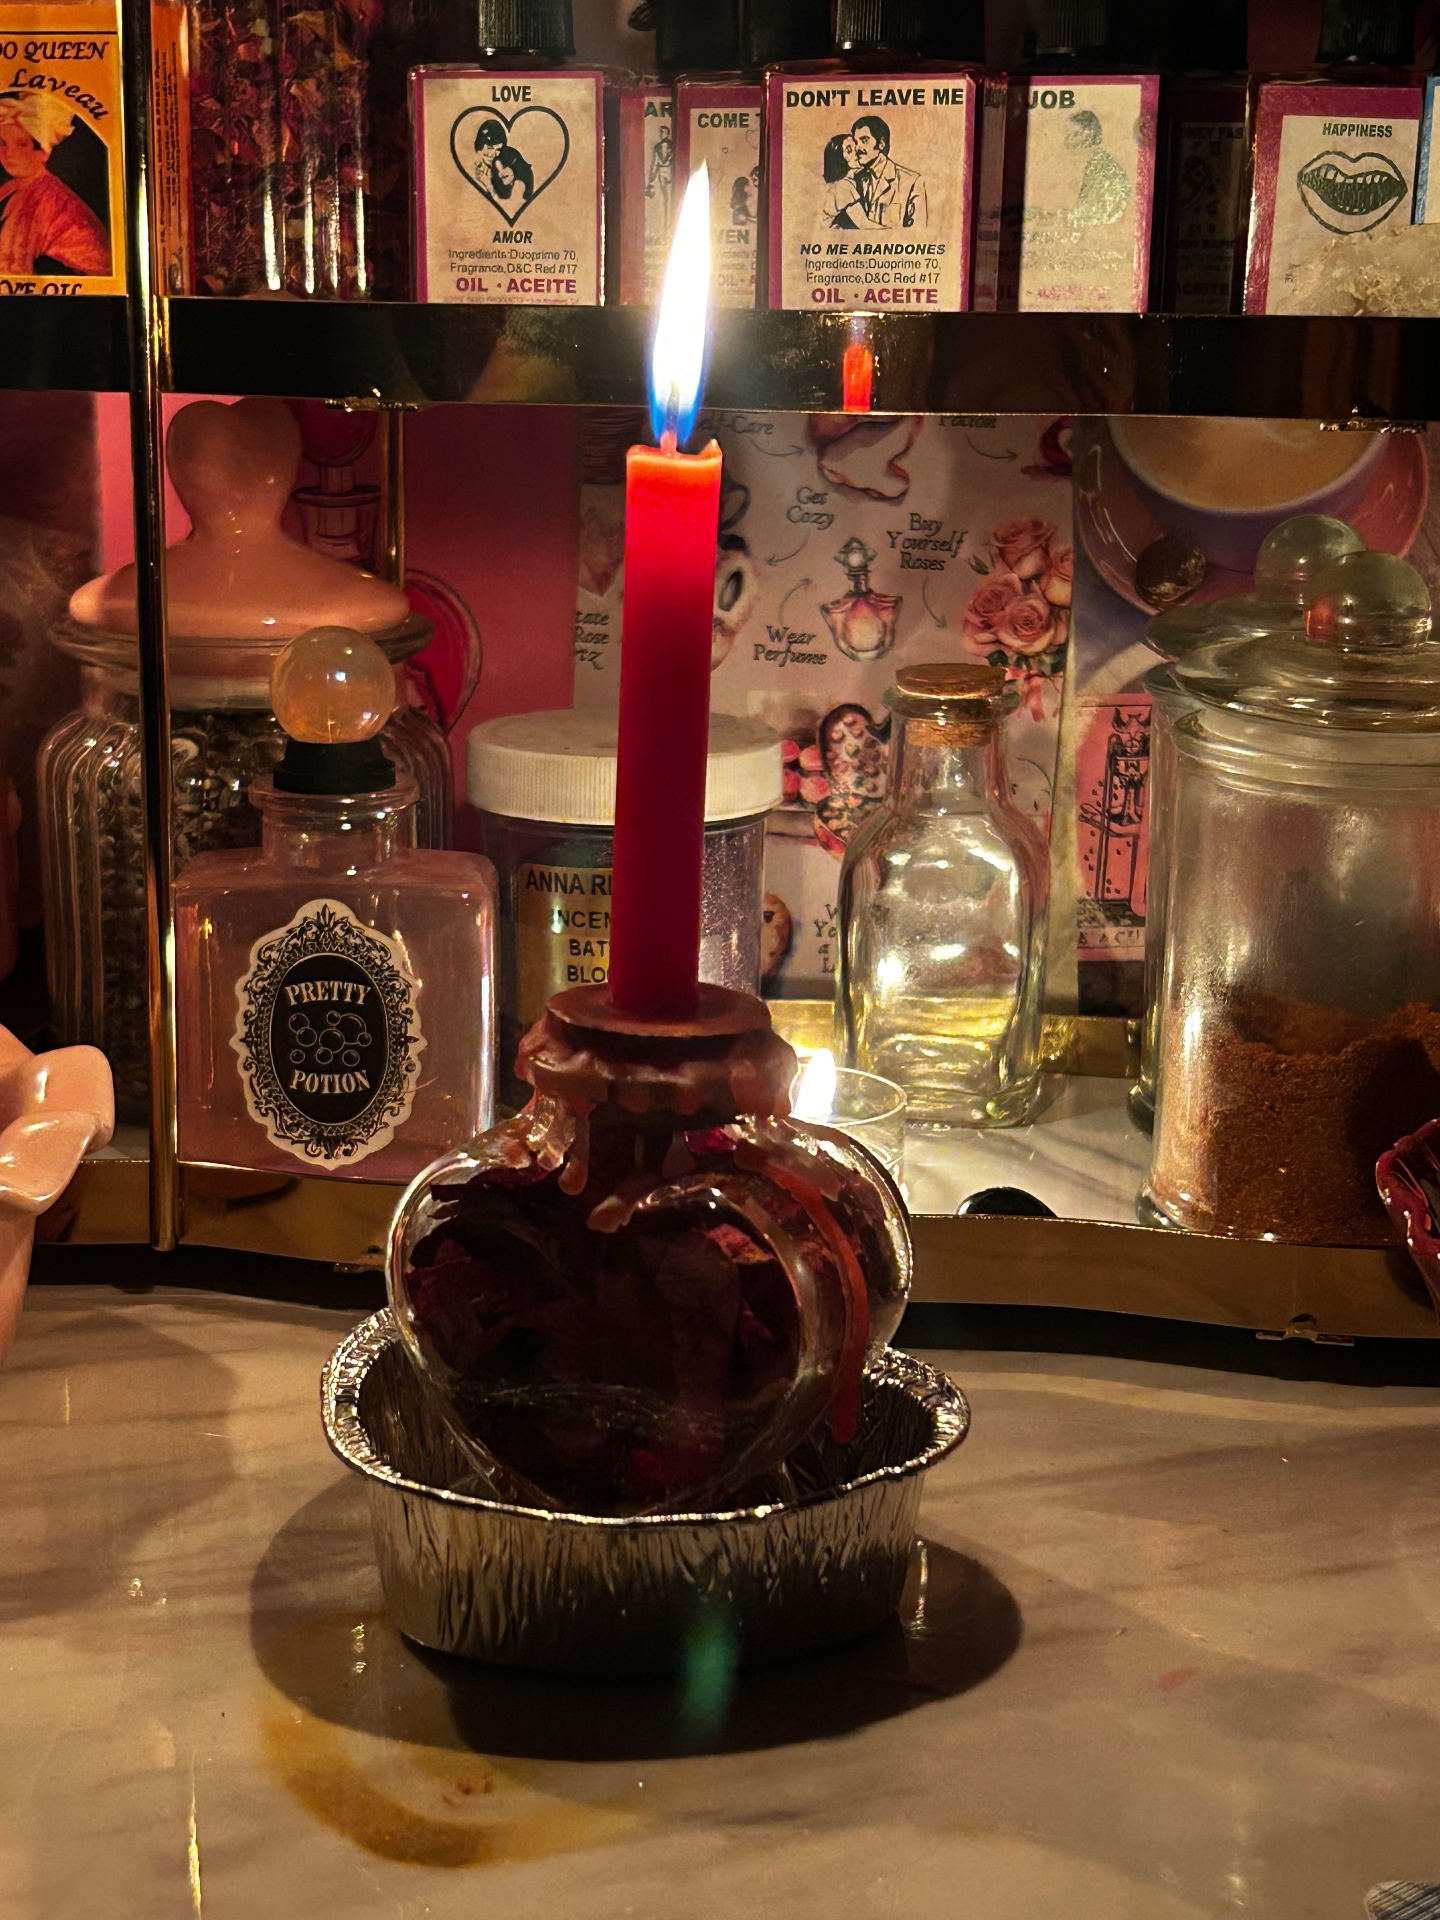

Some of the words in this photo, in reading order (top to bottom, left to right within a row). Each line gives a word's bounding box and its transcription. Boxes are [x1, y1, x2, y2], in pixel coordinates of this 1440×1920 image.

[24, 41, 109, 63] QUEEN
[9, 69, 109, 121] Laveau
[492, 86, 531, 103] LOVE
[786, 90, 850, 107] DON'T
[857, 89, 925, 106] LEAVE
[933, 88, 964, 105] ME
[1028, 90, 1076, 109] JOB
[697, 113, 750, 128] COME
[1322, 122, 1392, 138] HAPPINESS
[493, 231, 533, 244] AMOR
[800, 244, 822, 255] NO
[826, 244, 848, 255] ME
[852, 244, 946, 255] ABANDONES
[535, 264, 556, 274] Red
[558, 264, 578, 275] #17
[893, 272, 916, 284] Red
[919, 272, 940, 284] #17
[456, 277, 488, 292] OIL
[506, 278, 577, 293] ACEITE
[811, 288, 845, 303] OIL
[863, 288, 938, 304] ACEITE
[796, 486, 828, 505] Get
[786, 504, 835, 530] Cozy
[909, 512, 943, 534] Buy
[886, 530, 968, 559] Yourself
[900, 552, 946, 571] Roses
[766, 624, 817, 644] Wear
[753, 643, 828, 668] Perfume
[525, 869, 585, 895] ANNA
[284, 980, 372, 1006] PRETTY
[289, 1068, 371, 1095] POTION
